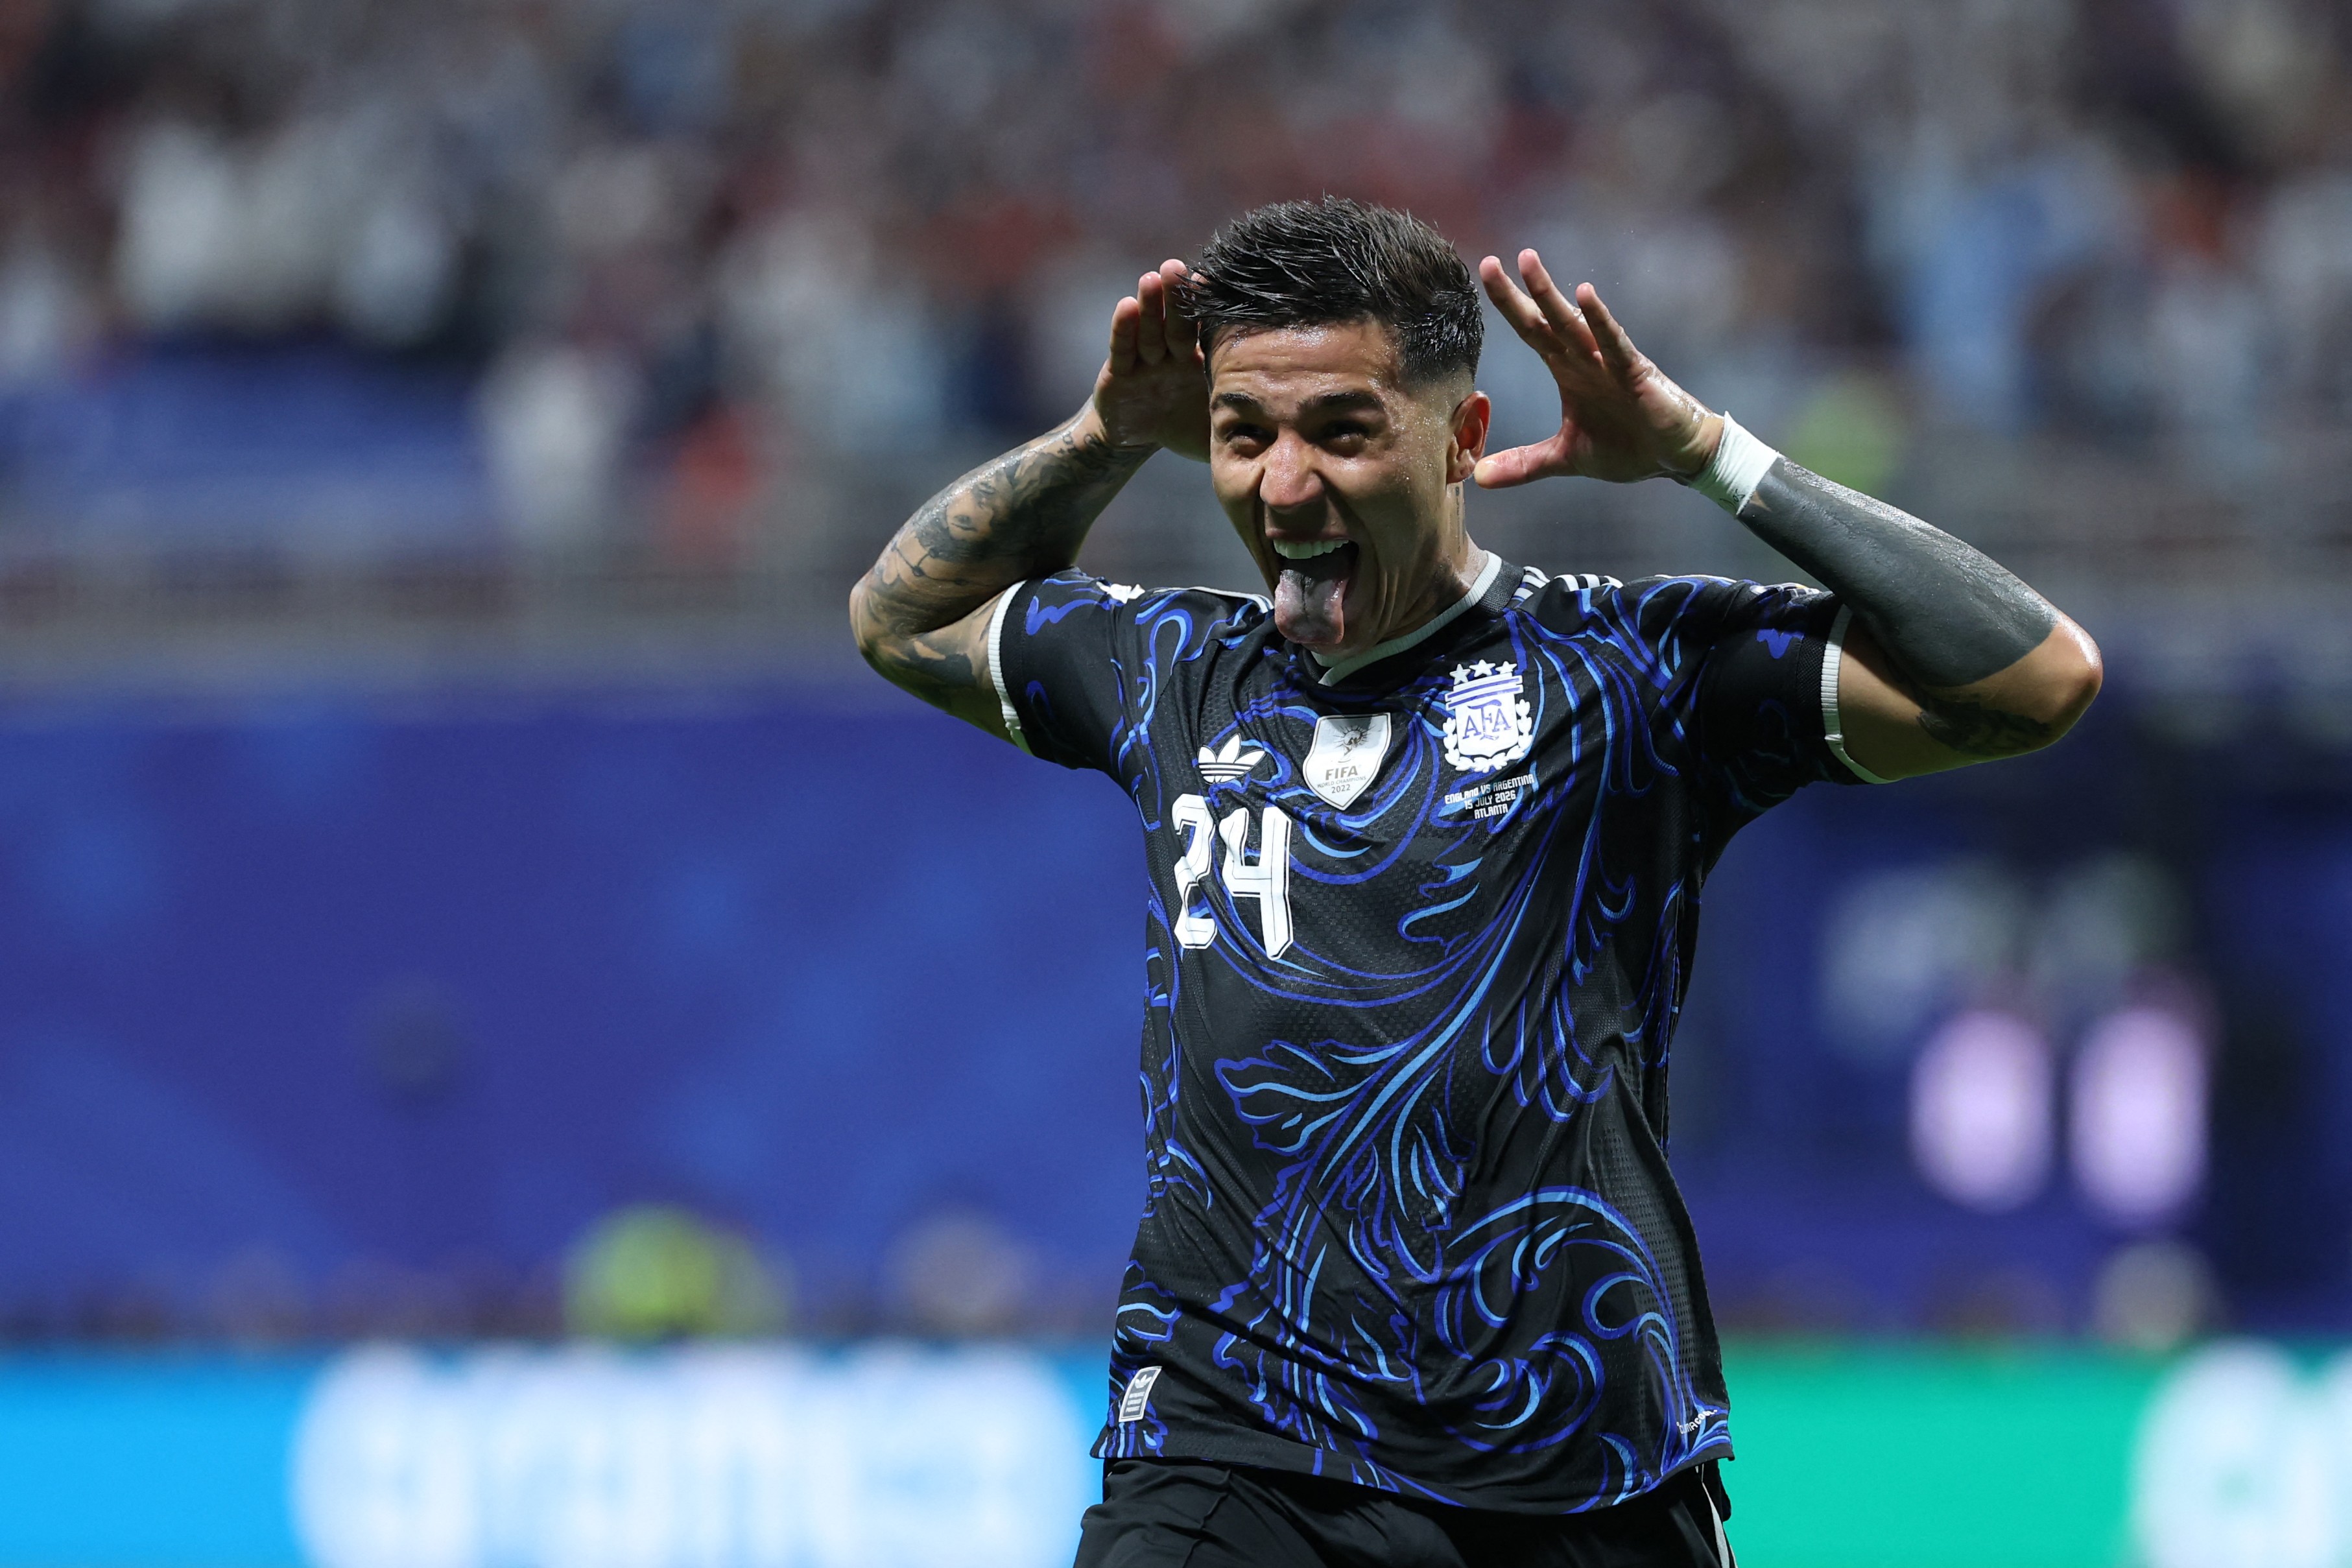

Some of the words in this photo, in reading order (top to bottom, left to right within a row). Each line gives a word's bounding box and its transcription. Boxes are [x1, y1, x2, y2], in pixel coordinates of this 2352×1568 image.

[1462, 699, 1512, 741] AFA
[1325, 765, 1358, 780] FIFA
[1336, 776, 1366, 784] CHAMPIONS
[1331, 784, 1350, 794] 2022
[1445, 787, 1479, 804] ENGLAND
[1481, 783, 1491, 794] VS
[1493, 774, 1534, 790] ARGENTINA
[1464, 800, 1473, 810] 15
[1475, 795, 1493, 807] JULY
[1495, 790, 1516, 803] 2026
[1474, 803, 1508, 818] ATLANTA
[1172, 793, 1294, 961] 24
